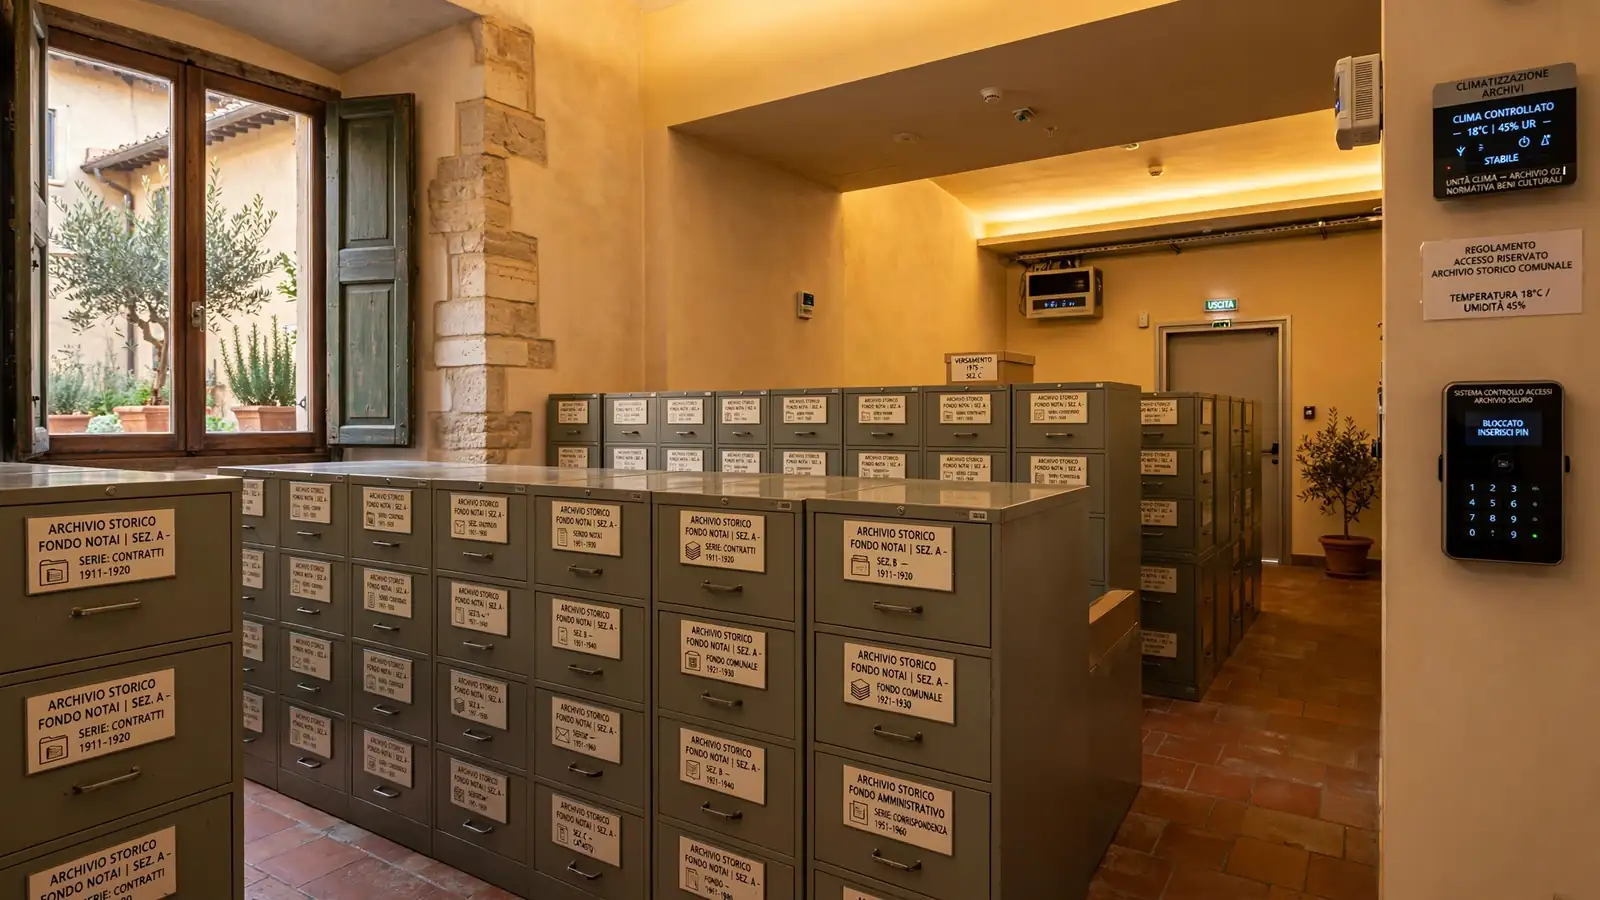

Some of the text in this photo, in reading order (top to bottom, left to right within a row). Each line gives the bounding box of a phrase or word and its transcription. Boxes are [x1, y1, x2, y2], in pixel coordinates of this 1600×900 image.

[1456, 69, 1549, 91] CLIMATIZZAZIONE
[1482, 84, 1524, 98] ARCHIVI
[1453, 102, 1554, 124] CLIMA CONTROLLATO
[1467, 119, 1536, 137] 18°C 45% UR
[1484, 153, 1519, 165] STABILE
[1446, 167, 1561, 187] UNITÀ CLIMA ARCHIVIO 02
[1446, 175, 1562, 195] NORMATIVA BENI CULTURALI
[1465, 241, 1536, 254] REGOLAMENTO
[1453, 251, 1549, 266] ACCESSO RISERVATO
[1431, 261, 1572, 278] ARCHIVIO STORICO COMUNALE
[1450, 290, 1518, 302] TEMPERATURA
[1520, 289, 1543, 299] 18°C
[1207, 300, 1235, 310] USCITA
[1464, 300, 1526, 312] UMIDITÀ 45%
[1508, 396, 1533, 404] SICURO
[1477, 428, 1529, 436] INSERISCI PIN
[1489, 484, 1496, 492] 2
[454, 507, 469, 516] FONDO
[458, 499, 499, 508] ARCHIVIO STORICO
[560, 506, 610, 517] ARCHIVIO STORICO
[1510, 500, 1517, 508] 6
[48, 516, 156, 535] ARCHIVIO STORICO
[556, 516, 575, 525] FONDO
[575, 518, 592, 527] NOTAI
[690, 516, 752, 528] ARCHIVIO STORICO
[1489, 514, 1496, 522] 8
[1511, 515, 1517, 523] 9
[38, 537, 82, 552] FONDO
[85, 534, 120, 547] NOTAI
[132, 532, 154, 544] SEZ.
[685, 528, 708, 537] FONDO
[709, 529, 729, 539] NOTAI
[735, 531, 750, 541] SEZ.
[857, 526, 935, 541] ARCHIVIO STORICO
[1469, 529, 1517, 539] 0 9
[723, 545, 756, 555] CONTRATTI
[850, 539, 879, 550] FONDO
[881, 542, 907, 553] NOTAI
[915, 545, 933, 555] SEZ.
[79, 548, 164, 565] SERIE: CONTRATTI
[705, 554, 734, 563] 1911-1920
[893, 558, 898, 567] B
[79, 565, 130, 580] 1911-1920
[556, 613, 575, 625] FONDO
[561, 604, 610, 620] ARCHIVIO STORICO
[691, 626, 753, 644] ARCHIVIO STORICO
[686, 637, 709, 649] FONDO
[710, 642, 730, 652] NOTAI
[736, 646, 751, 656] SEZ.
[706, 654, 758, 671] FONDO COMUNALE
[858, 650, 936, 671] ARCHIVIO STORICO
[851, 662, 880, 676] FONDO
[882, 668, 907, 680] NOTAI
[916, 675, 934, 685] SEZ.
[47, 678, 156, 711] ARCHIVIO STORICO
[877, 683, 943, 703] FONDO COMUNALE
[877, 695, 912, 709] 1921-1930
[38, 711, 81, 730] FONDO
[85, 702, 120, 718] NOTAI
[131, 695, 154, 708] SEZ.
[560, 703, 610, 723] ARCHIVIO STORICO
[78, 709, 164, 739] SERIE: CONTRATTI
[79, 732, 130, 753] 1911-1920
[690, 736, 752, 758] ARCHIVIO STORICO
[686, 746, 709, 759] FONDO
[709, 752, 729, 765] NOTAI
[736, 759, 750, 771] SEZ.
[857, 774, 935, 801] ARCHIVIO STORICO
[849, 785, 945, 818] FONDO AMMINISTRATIVO
[893, 813, 948, 836] CORRISPONDENZA
[50, 839, 157, 886] ARCHIVIO STORICO
[690, 844, 751, 872] ARCHIVIO STORICO
[40, 882, 83, 900] FONDO
[87, 867, 121, 888] NOTAI
[133, 855, 155, 871] SEZ.
[684, 854, 750, 885] FONDO NOTAI SEZ.
[84, 868, 165, 900] ERIE: CONTRATTI
